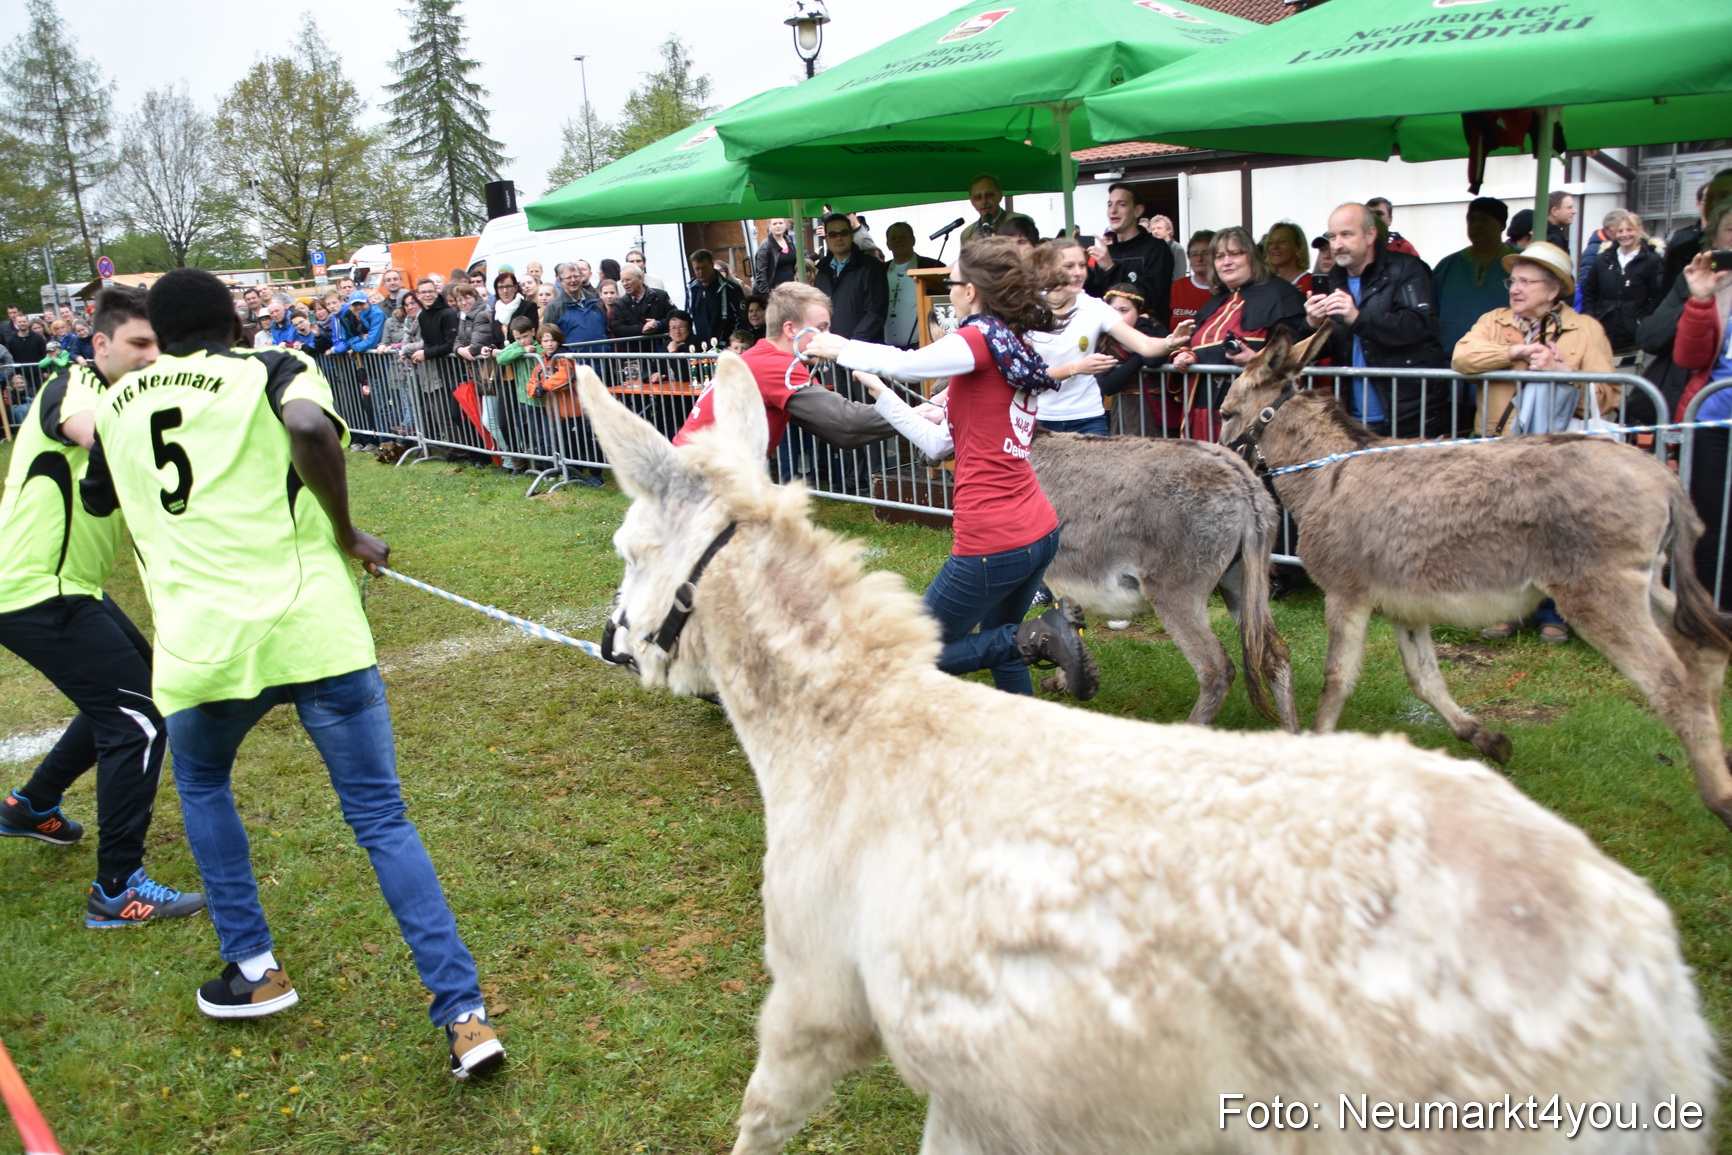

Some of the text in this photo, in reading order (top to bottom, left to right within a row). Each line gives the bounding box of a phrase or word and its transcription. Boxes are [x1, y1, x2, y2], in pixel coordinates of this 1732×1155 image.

[1287, 15, 1595, 65] Lammsbräu
[1345, 4, 1570, 42] Neumarkter
[150, 406, 193, 515] 5
